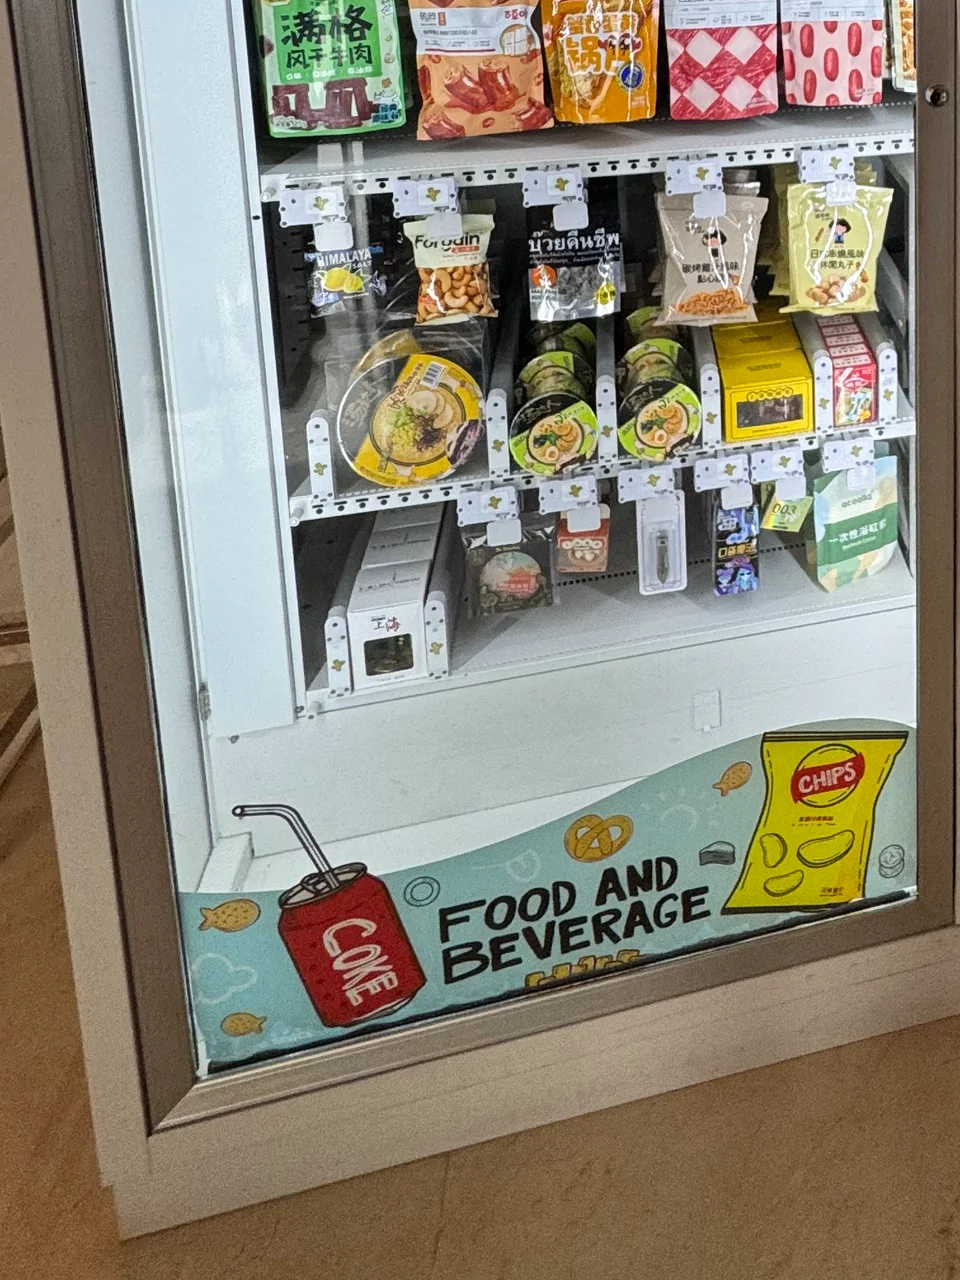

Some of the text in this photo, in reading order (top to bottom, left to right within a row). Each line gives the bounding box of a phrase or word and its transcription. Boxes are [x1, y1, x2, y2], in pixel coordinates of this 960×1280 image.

[281, 5, 373, 47] 满格
[286, 43, 373, 70] 风干牛肉
[528, 228, 620, 253] บ๊วยคืนชีพ
[316, 248, 373, 268] HIMALAYA
[352, 261, 373, 270] SALT
[772, 503, 796, 516] 003
[797, 761, 856, 795] CHIPS
[438, 855, 678, 944] FOOD AND
[441, 886, 712, 986] BEVERAGE
[322, 918, 399, 1007] COKE
